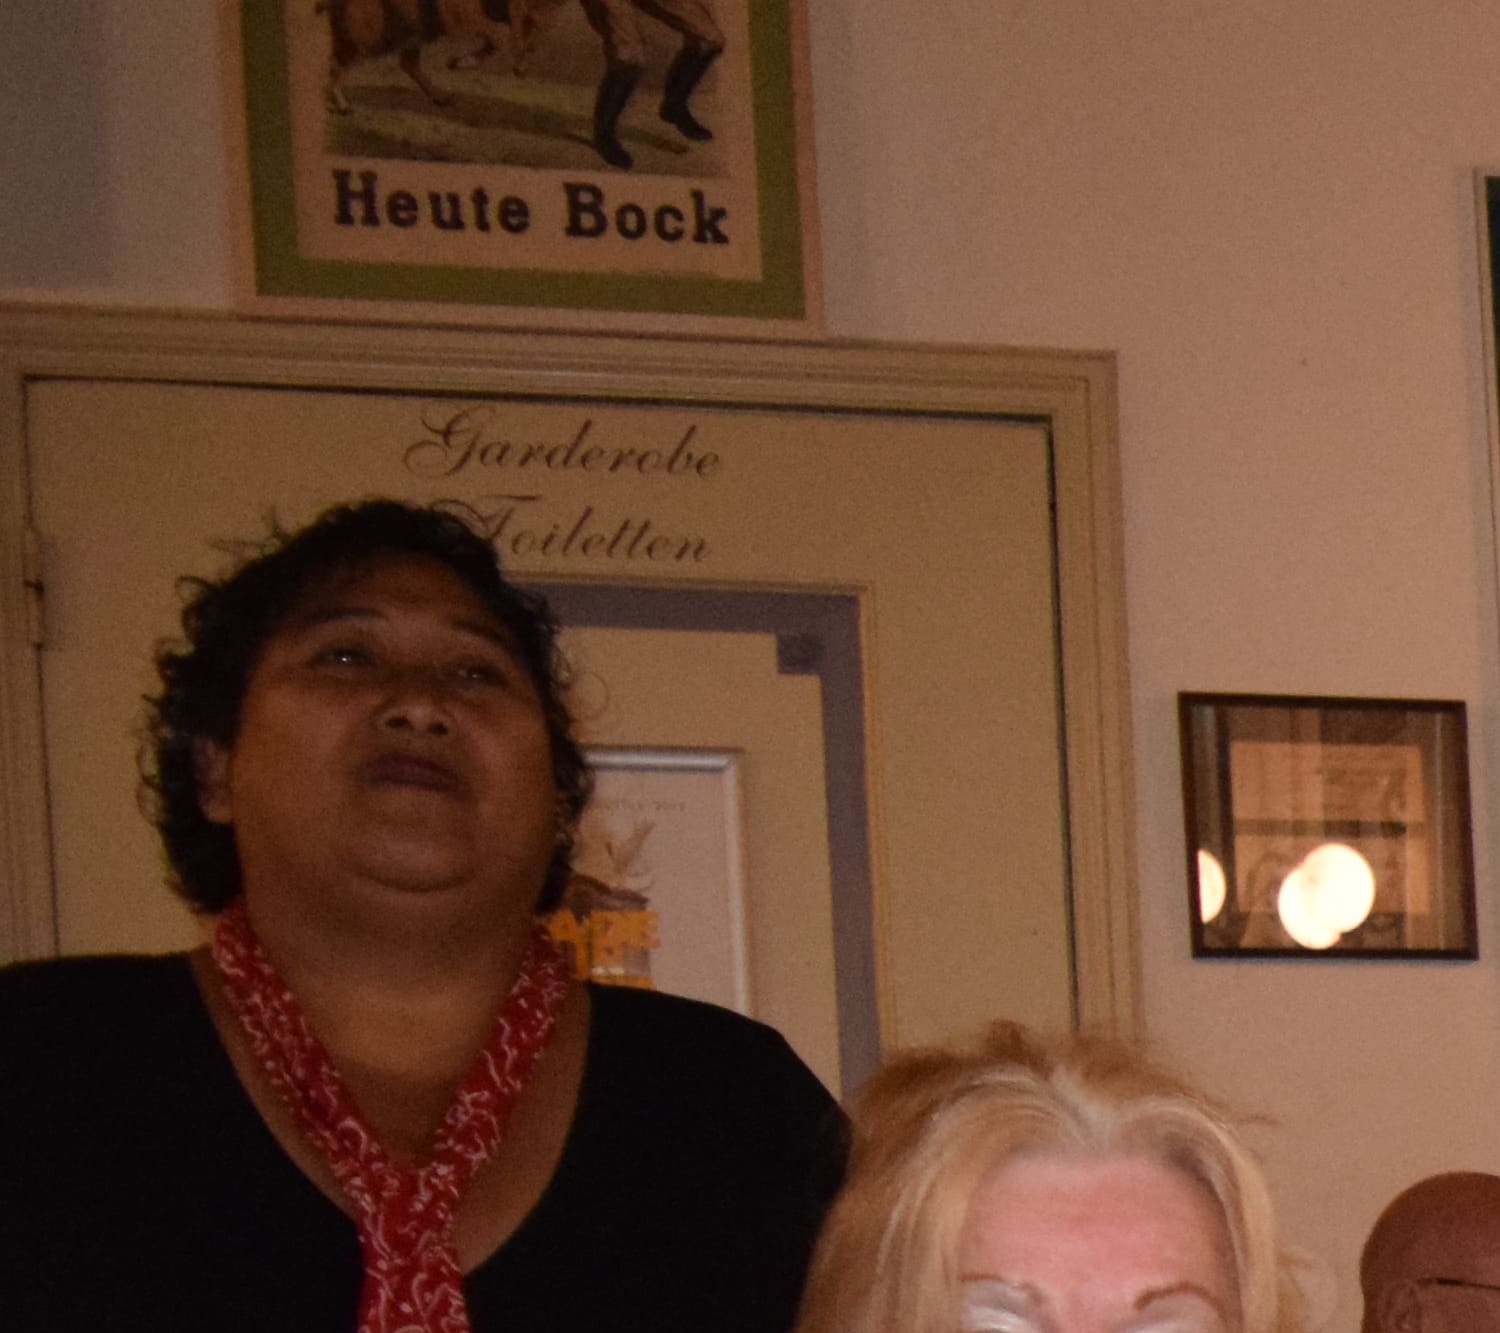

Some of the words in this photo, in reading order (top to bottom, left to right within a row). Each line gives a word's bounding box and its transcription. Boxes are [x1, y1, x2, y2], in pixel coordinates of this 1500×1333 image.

[332, 168, 533, 234] Heute
[563, 181, 731, 244] Bock
[404, 405, 724, 480] Garderobe
[430, 493, 714, 562] Toiletten
